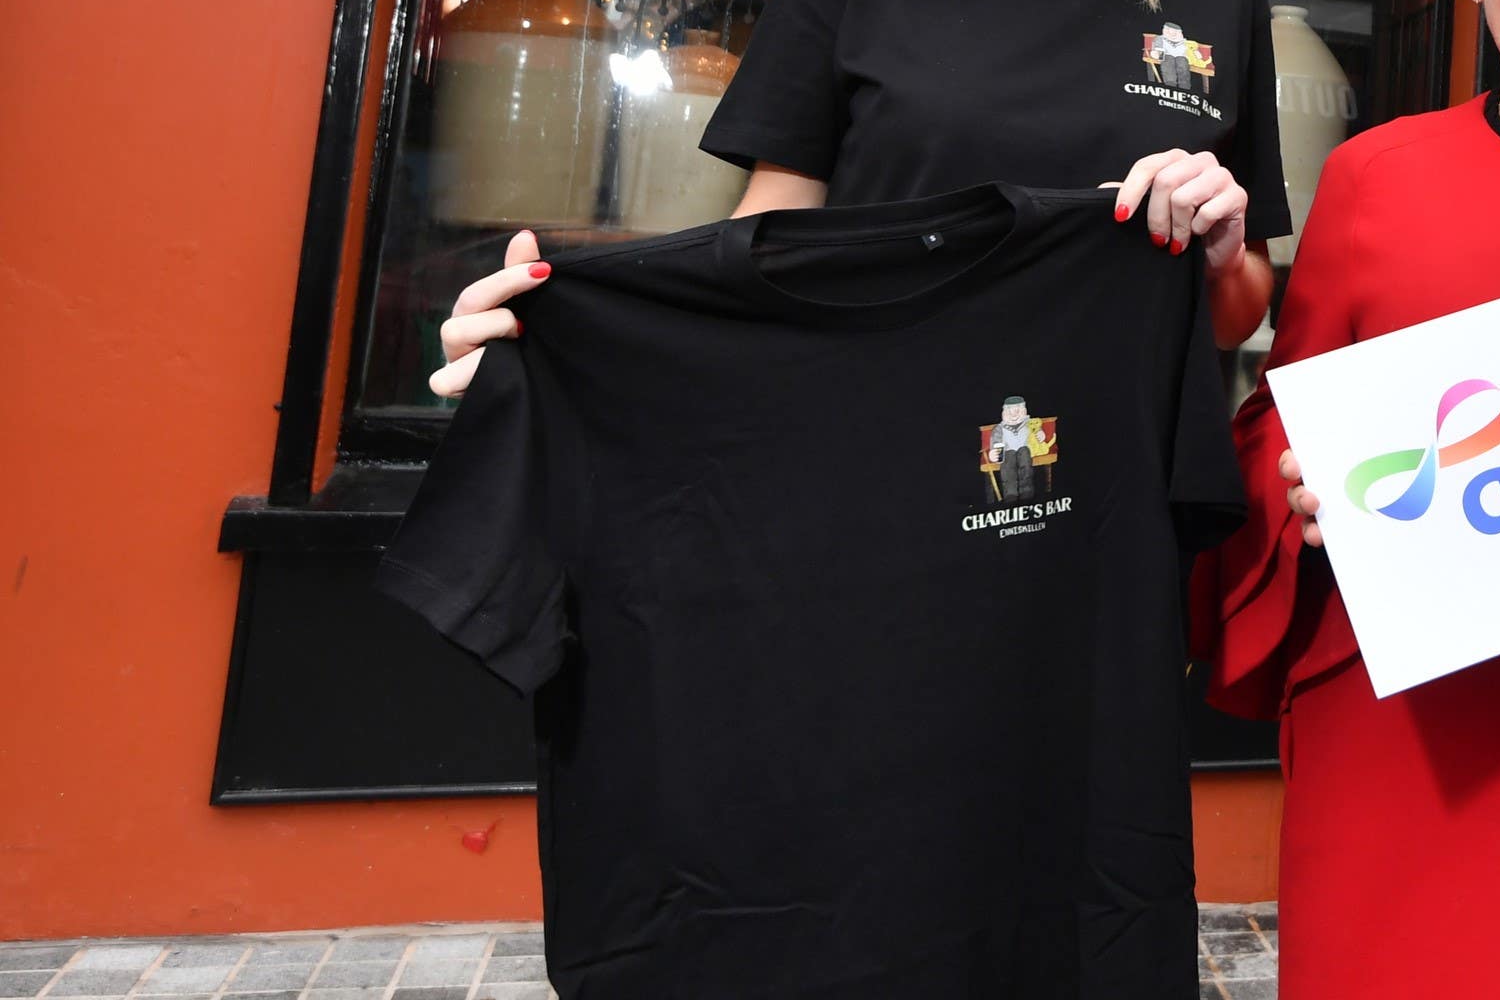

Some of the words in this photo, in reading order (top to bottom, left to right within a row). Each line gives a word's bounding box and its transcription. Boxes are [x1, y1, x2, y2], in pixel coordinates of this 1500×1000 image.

[1124, 83, 1200, 106] CHARLIE'S
[1202, 99, 1223, 121] BAR
[962, 504, 1043, 532] CHARLIE'S
[1046, 497, 1072, 515] BAR
